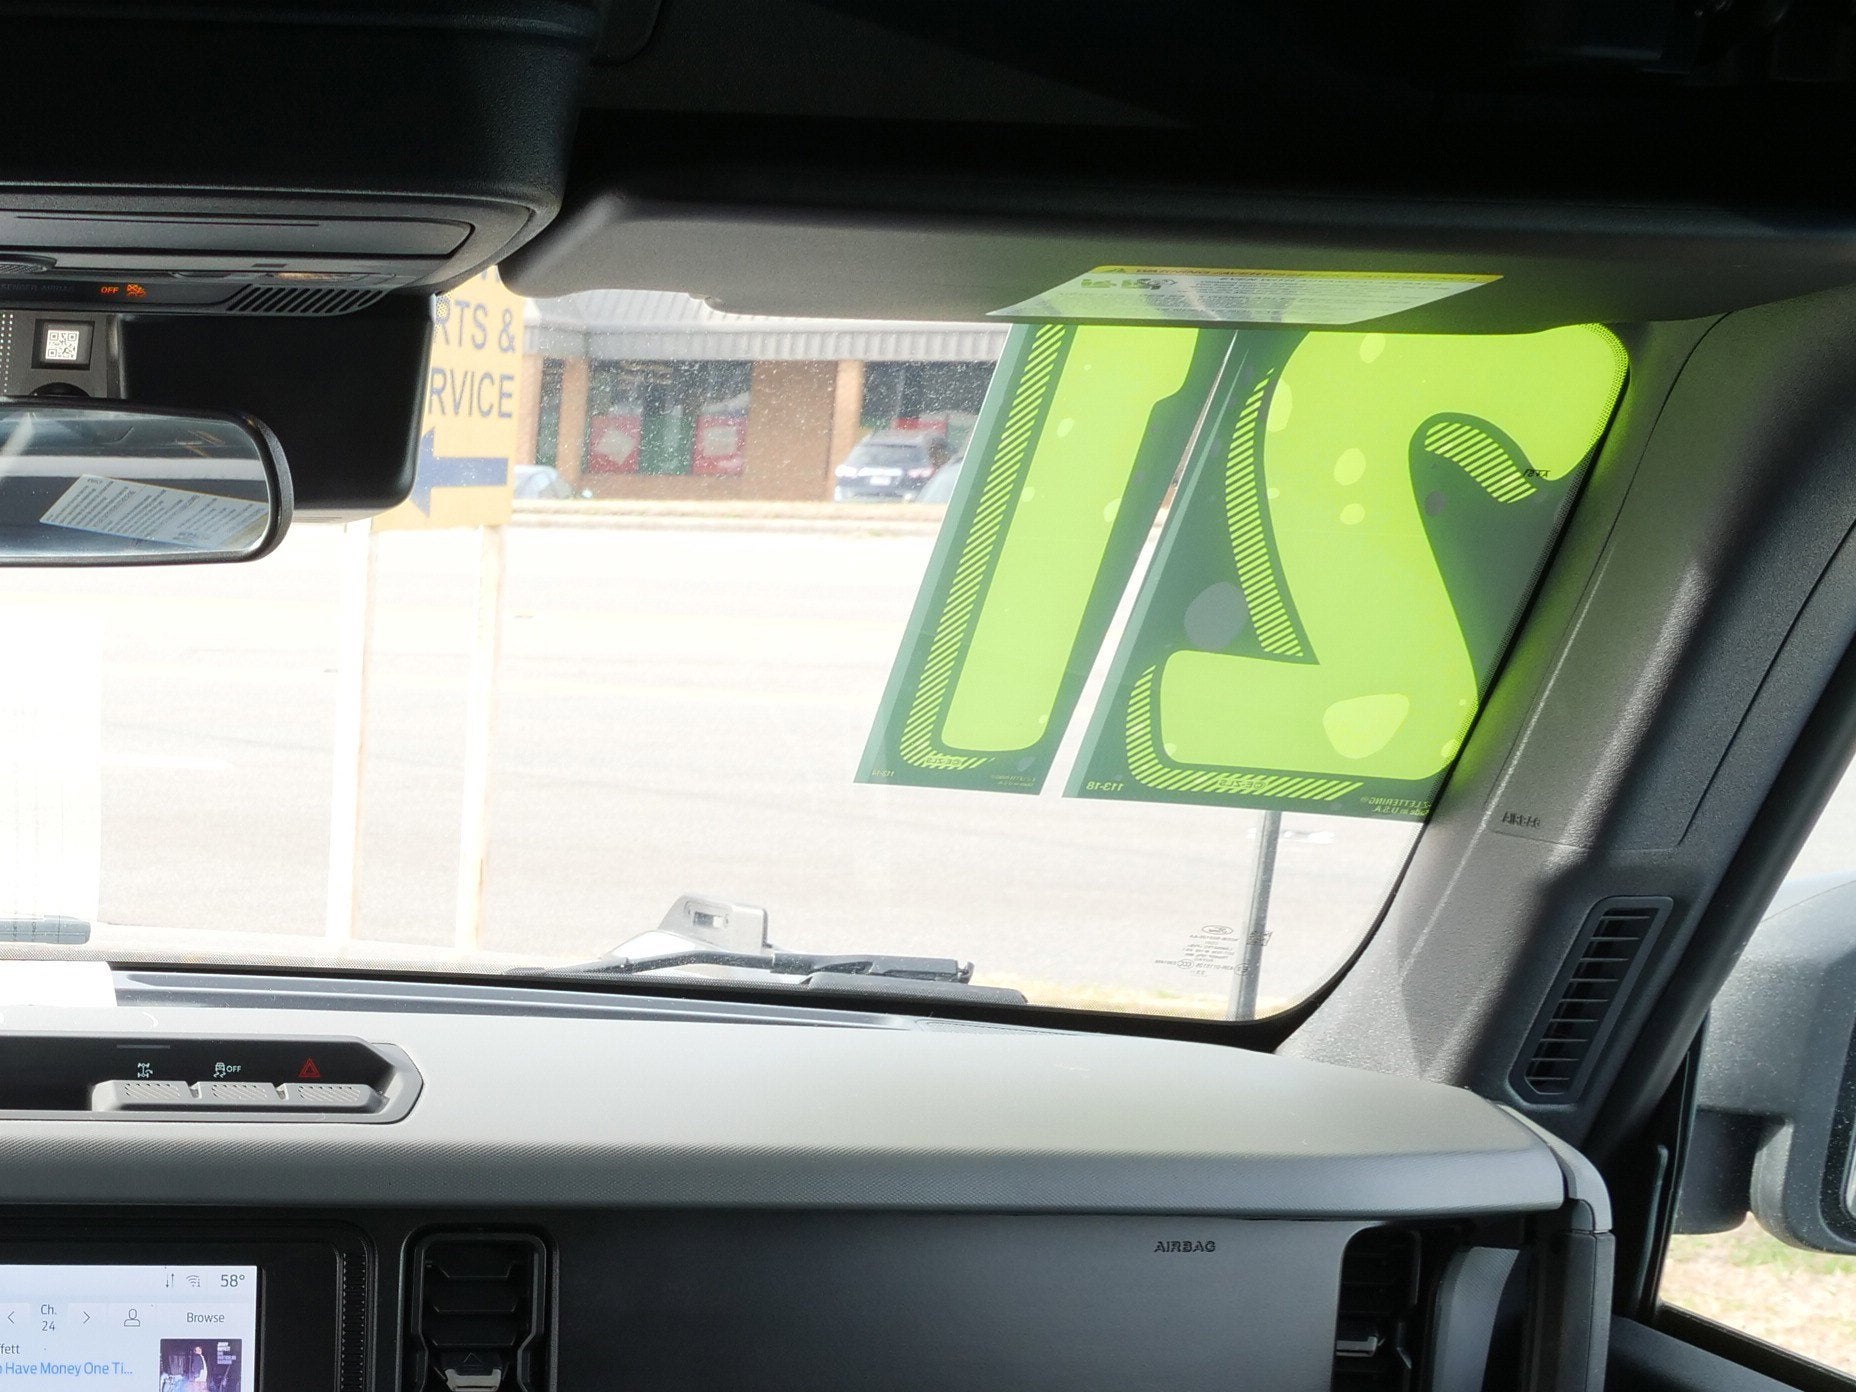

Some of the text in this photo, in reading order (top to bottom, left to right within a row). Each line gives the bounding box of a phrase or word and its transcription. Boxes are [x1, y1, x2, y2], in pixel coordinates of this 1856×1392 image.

[100, 286, 120, 295] OFF
[498, 309, 516, 352] &
[1154, 1240, 1218, 1254] AIRBAG
[220, 1274, 246, 1288] 58°
[40, 1304, 58, 1316] Ch.
[186, 1311, 225, 1324] Browse
[41, 1320, 55, 1333] 24
[5, 1361, 37, 1376] Have
[40, 1361, 83, 1378] Money
[85, 1361, 110, 1376] One
